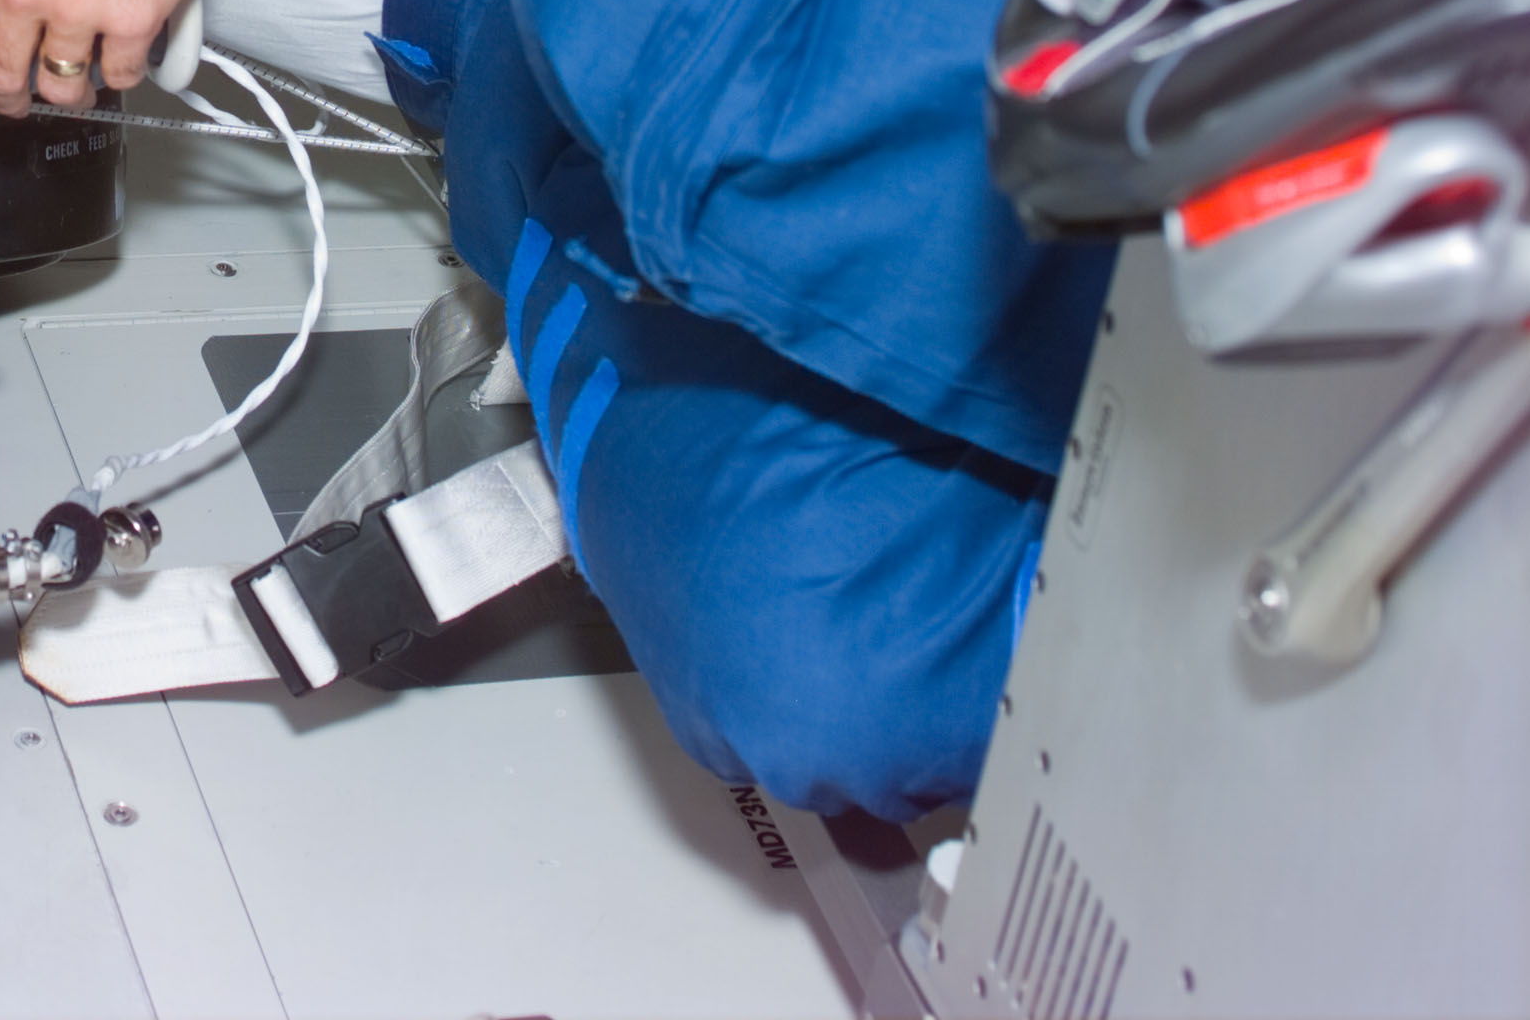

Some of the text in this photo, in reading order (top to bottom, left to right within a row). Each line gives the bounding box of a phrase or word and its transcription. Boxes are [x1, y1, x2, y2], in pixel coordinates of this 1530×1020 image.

[45, 140, 80, 161] CHECK
[88, 133, 108, 152] FEED
[729, 786, 799, 869] MD73N
